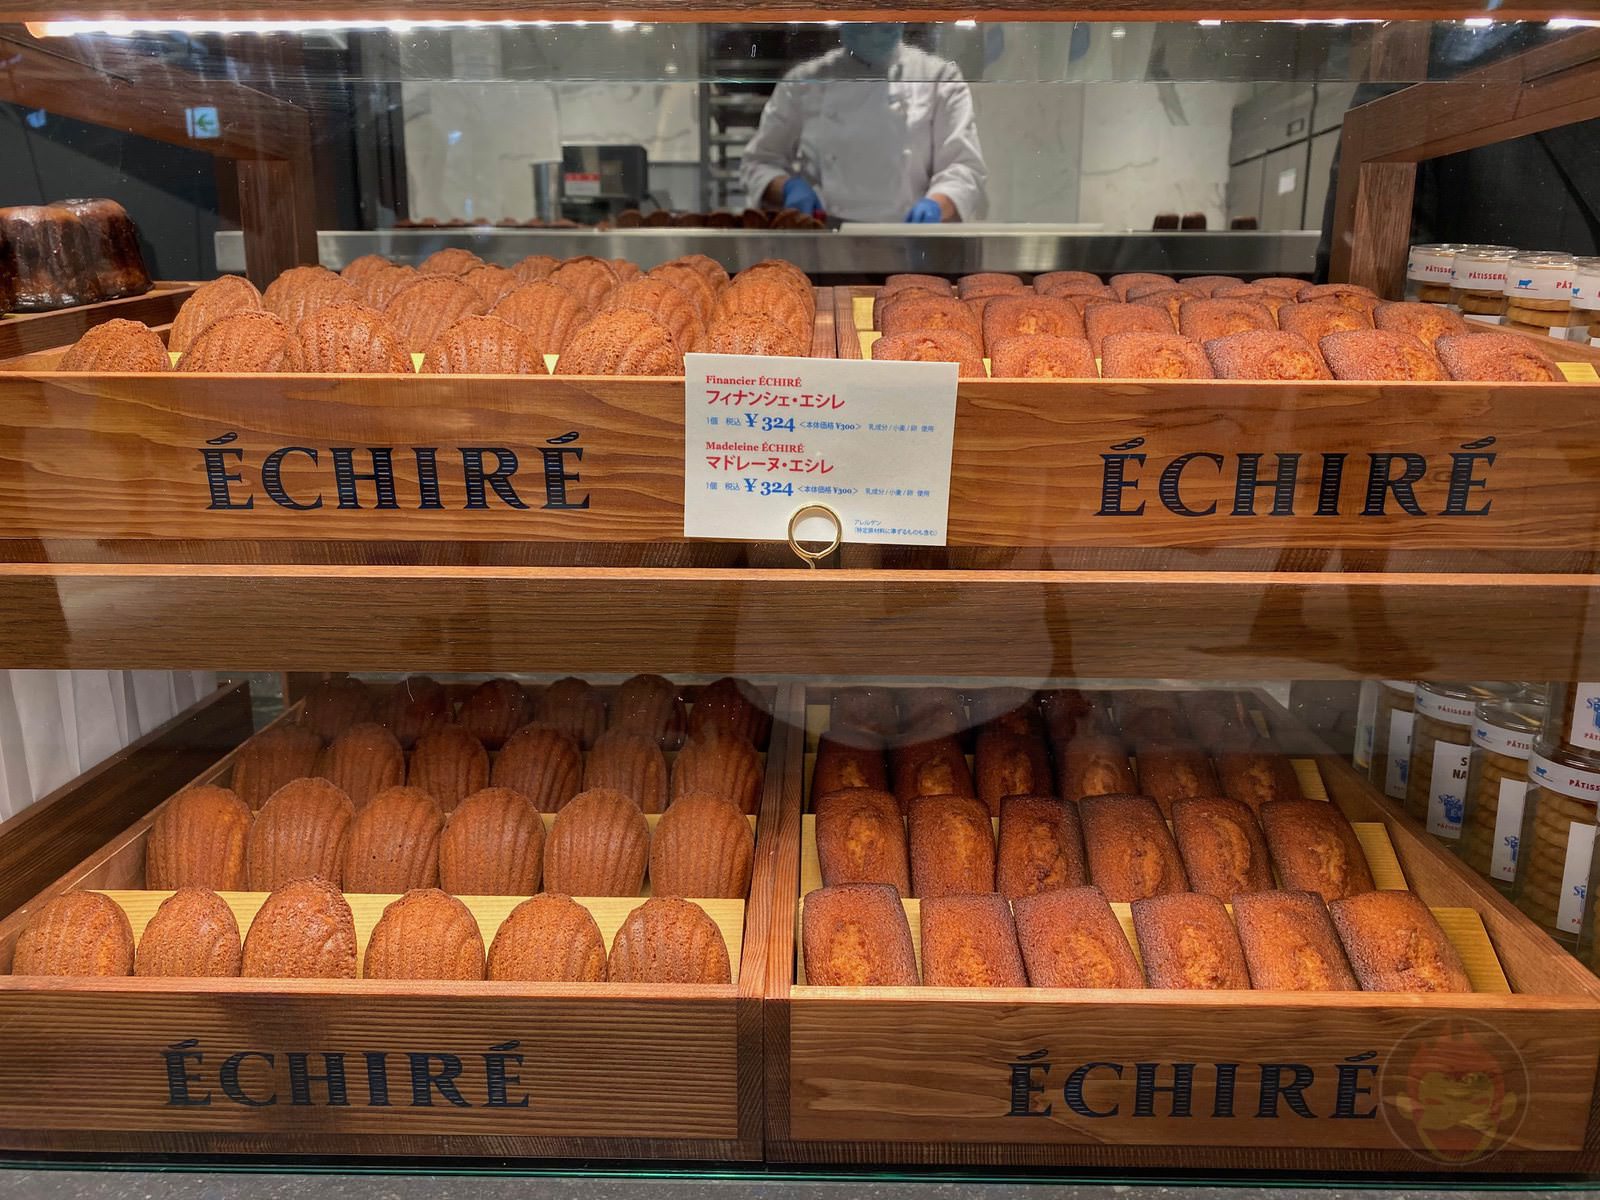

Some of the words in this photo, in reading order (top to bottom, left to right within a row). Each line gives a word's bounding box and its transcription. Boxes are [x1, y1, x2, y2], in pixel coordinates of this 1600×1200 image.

[705, 389, 846, 410] フィナンシェ・エシレ
[706, 375, 756, 386] Financier
[758, 376, 802, 388] ÉCHIRÉ
[705, 441, 759, 452] Madeleine
[761, 442, 804, 453] ÉCHIRÉ
[705, 454, 834, 475] マドレーヌ・エシレ
[198, 431, 590, 510] ÉCHIRÉ
[1093, 436, 1498, 517] ÉCHIRÉ
[160, 1039, 530, 1108] ÉCHIRÉ
[1004, 1049, 1380, 1120] ÉCHIRÉ
